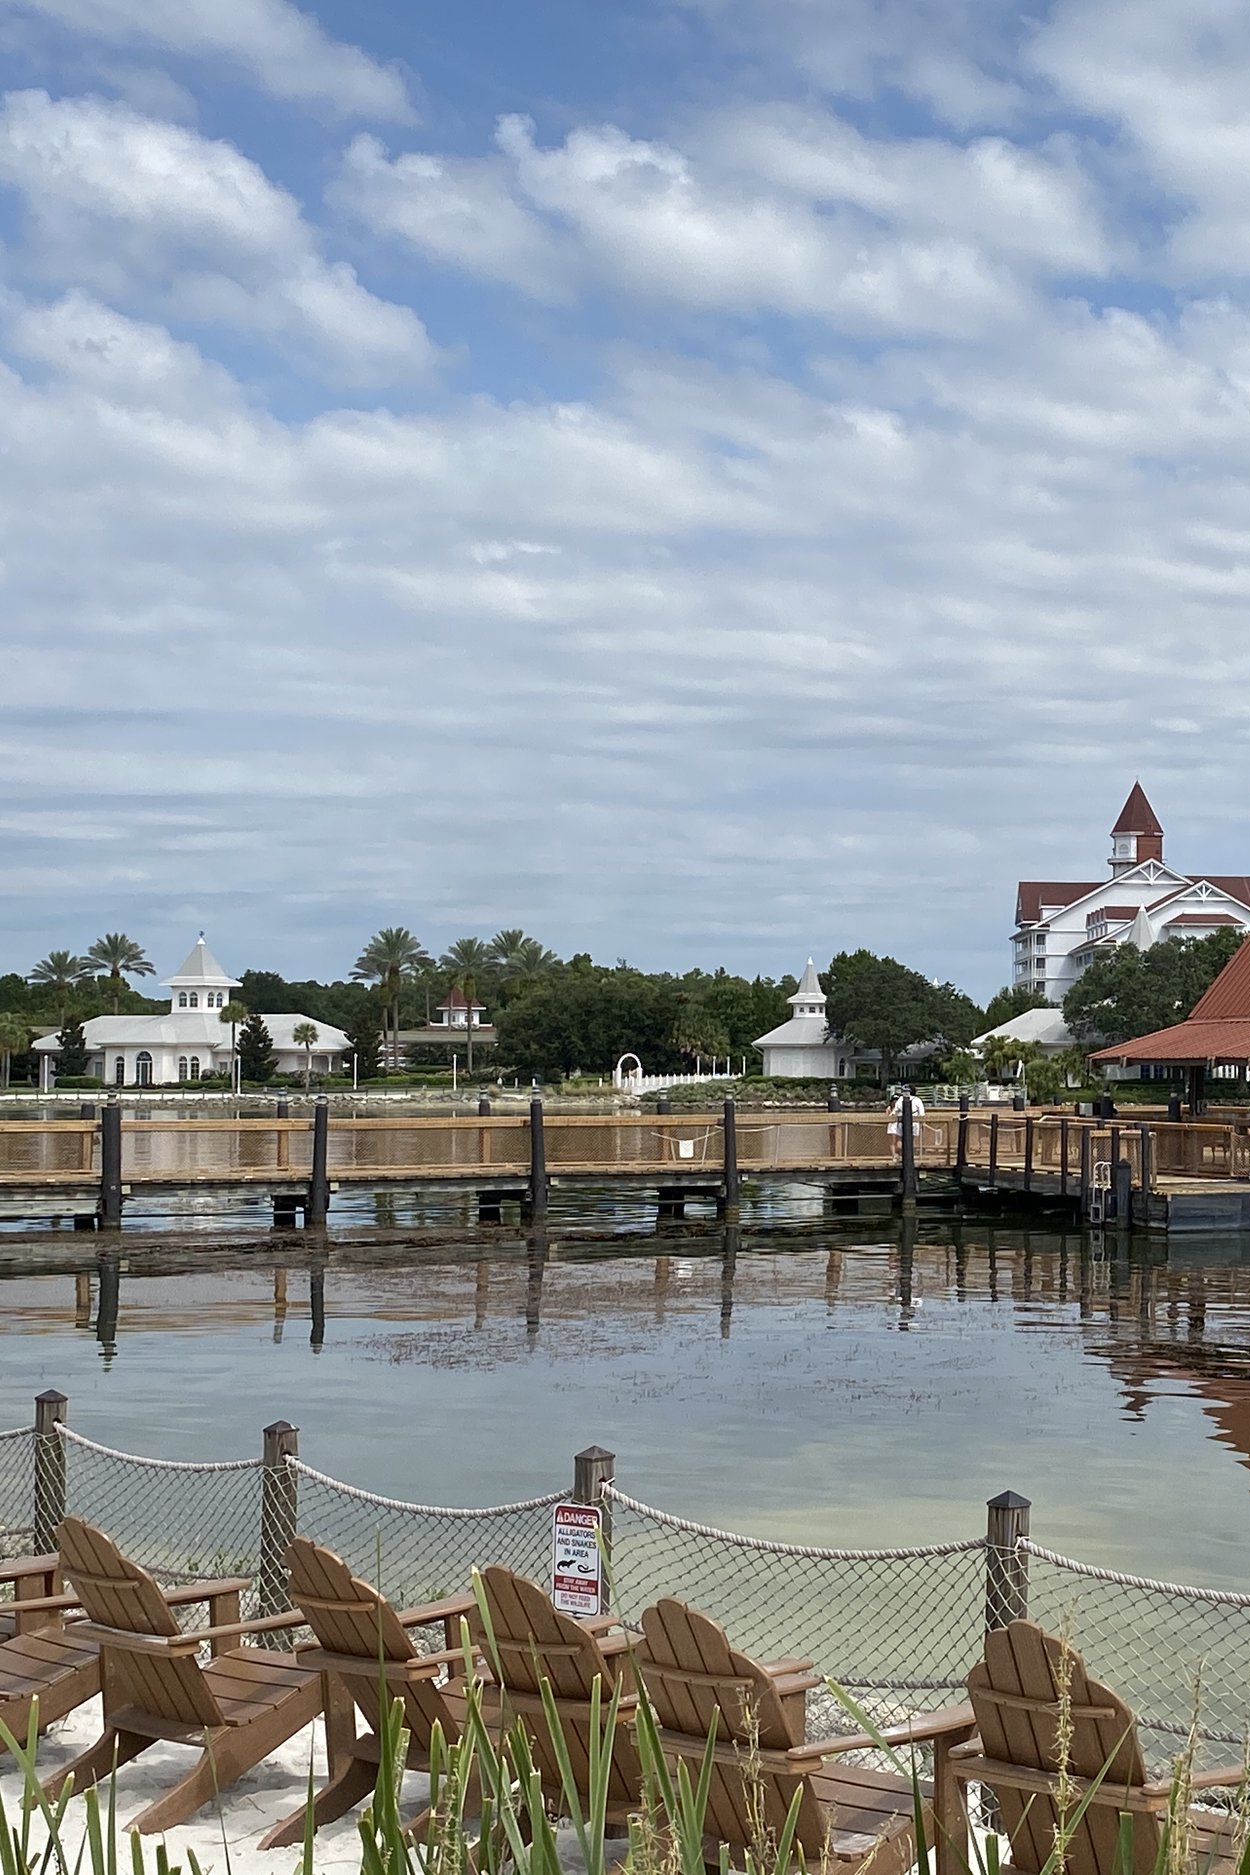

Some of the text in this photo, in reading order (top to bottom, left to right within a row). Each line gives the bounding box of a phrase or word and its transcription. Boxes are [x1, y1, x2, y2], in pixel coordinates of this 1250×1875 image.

[558, 1528, 595, 1539] ALLIGATORS
[572, 1539, 596, 1548] SNAKES
[572, 1550, 588, 1558] AREA
